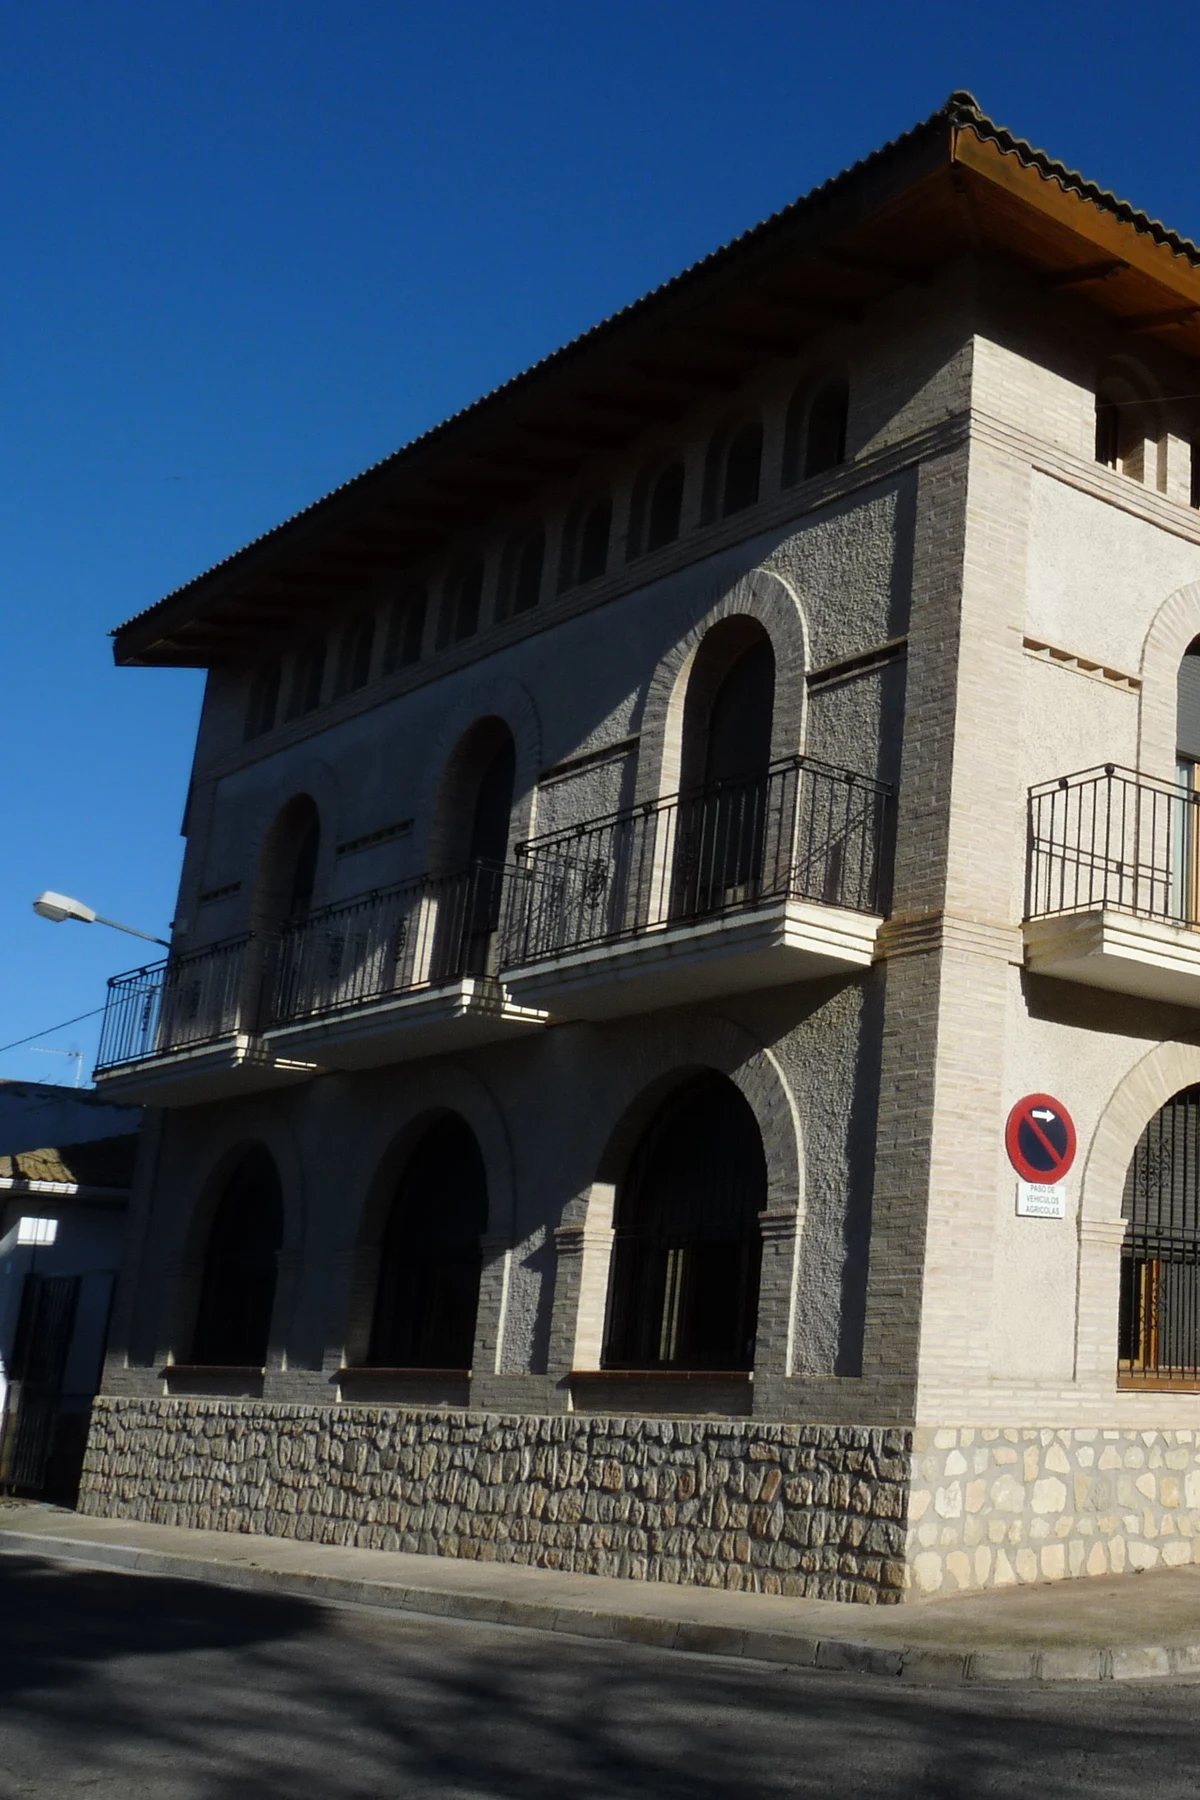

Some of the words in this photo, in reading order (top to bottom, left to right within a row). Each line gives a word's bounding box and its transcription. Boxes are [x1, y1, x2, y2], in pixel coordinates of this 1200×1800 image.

[1030, 1184, 1047, 1193] PASO
[1047, 1186, 1056, 1194] DE
[1026, 1194, 1060, 1205] VEHICULOS
[1025, 1205, 1060, 1215] AGRICOLAS
